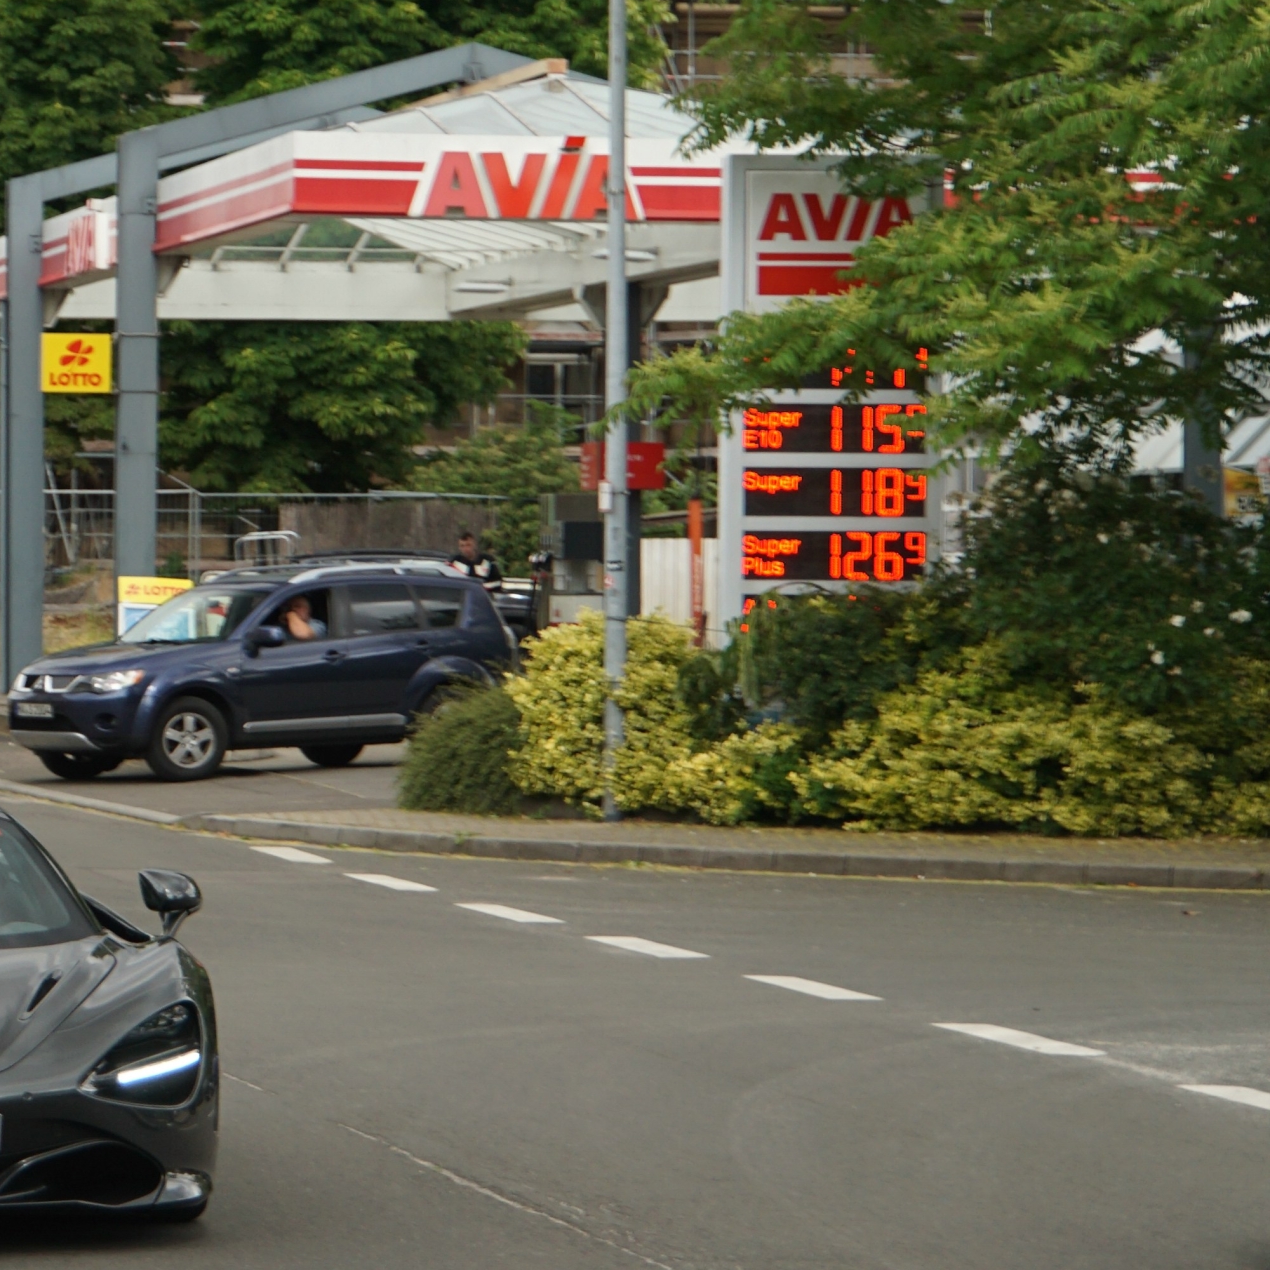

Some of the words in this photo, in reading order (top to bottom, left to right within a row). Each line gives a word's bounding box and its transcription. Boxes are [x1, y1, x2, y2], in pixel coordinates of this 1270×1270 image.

[422, 136, 638, 219] AVIA
[757, 193, 913, 241] AVIA
[49, 372, 102, 386] LOTTO
[742, 408, 803, 429] Super
[742, 430, 783, 449] E10
[742, 471, 803, 494] Super
[742, 534, 802, 558] Super
[742, 557, 785, 576] Plus
